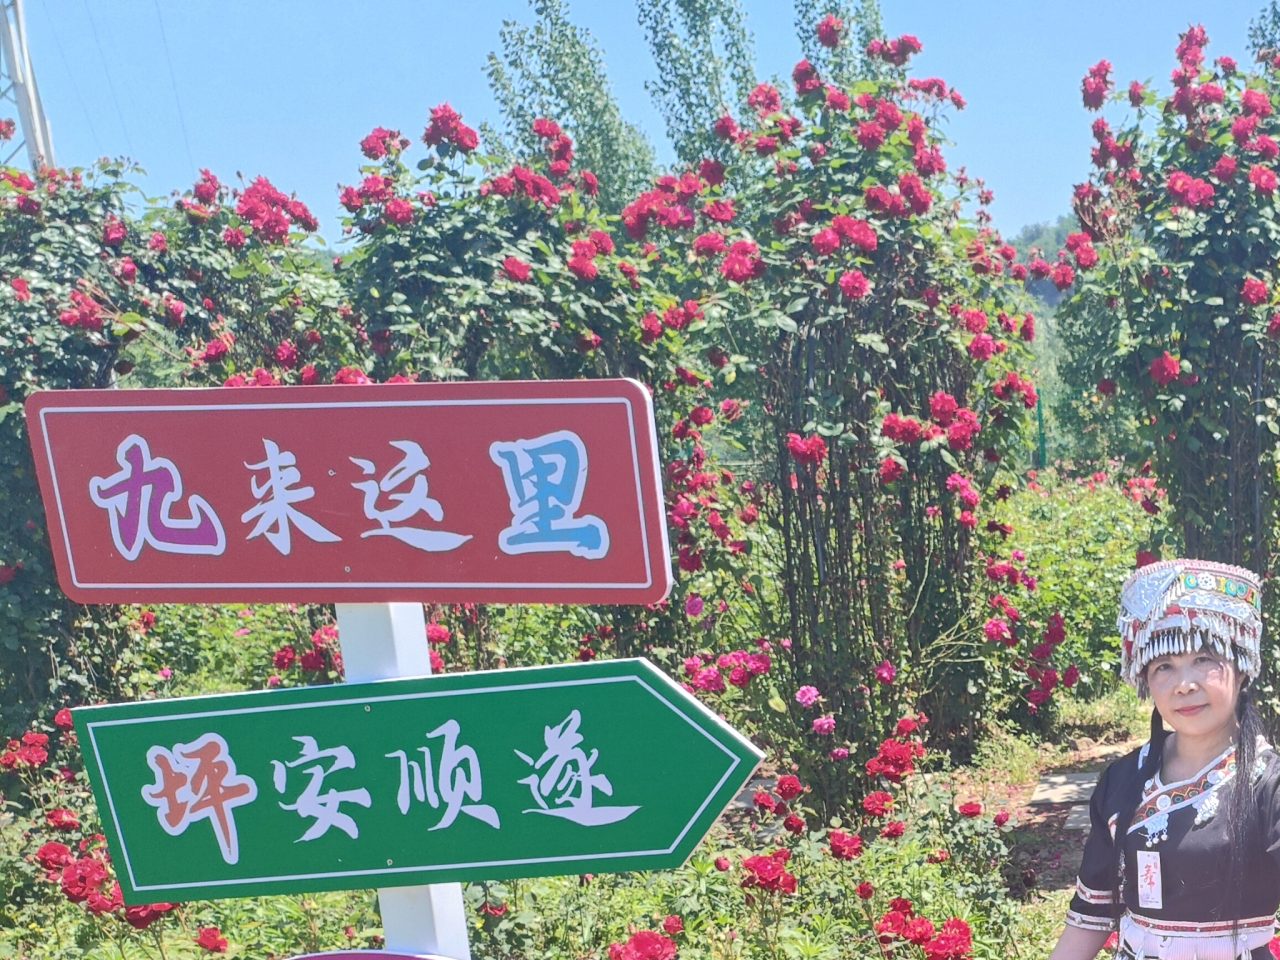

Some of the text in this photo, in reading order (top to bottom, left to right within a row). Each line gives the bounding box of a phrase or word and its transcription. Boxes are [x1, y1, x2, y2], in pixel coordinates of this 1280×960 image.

[90, 430, 610, 562] 九来这里
[141, 709, 643, 864] 坪安顺遂
